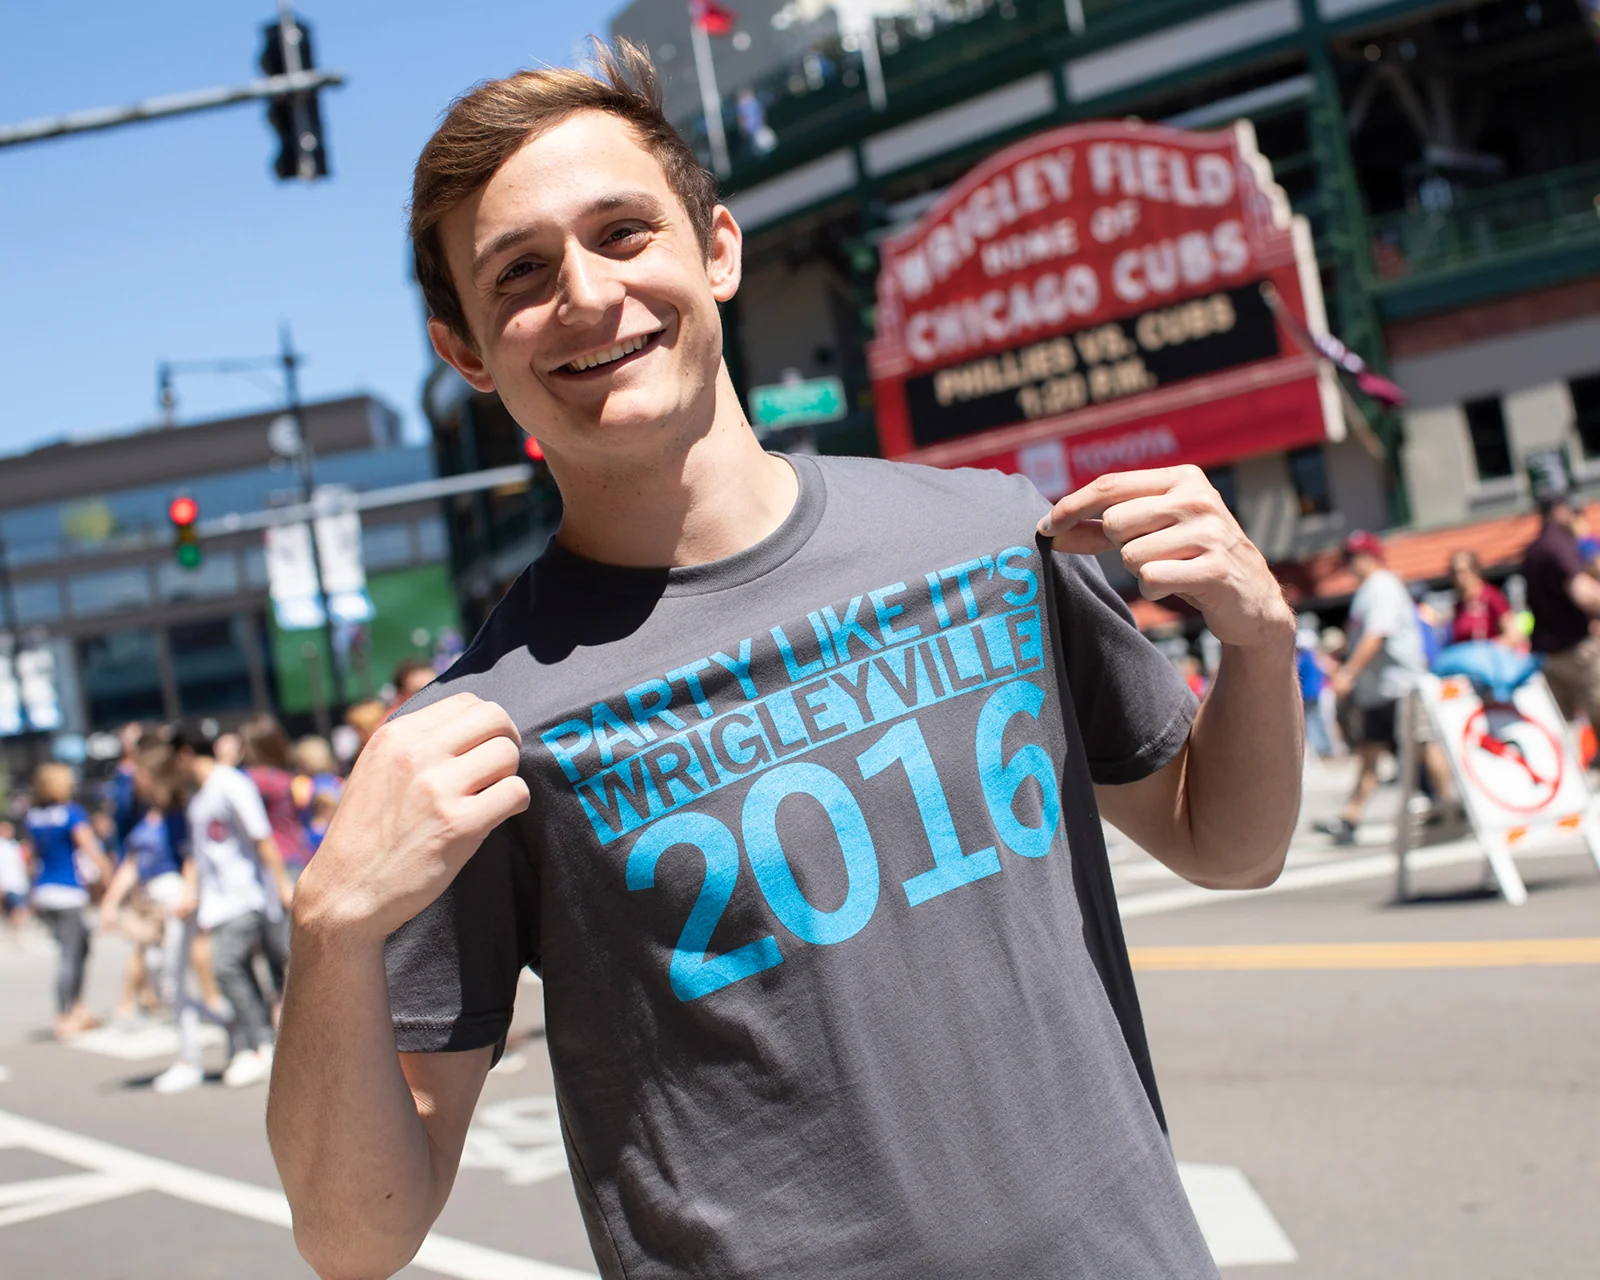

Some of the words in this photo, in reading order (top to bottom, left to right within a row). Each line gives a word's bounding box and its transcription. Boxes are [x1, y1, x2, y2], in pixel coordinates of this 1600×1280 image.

[897, 147, 1075, 299] WRIGLEY
[1088, 142, 1236, 207] FIELD
[907, 264, 1100, 362] CHICAGO
[1112, 219, 1250, 302] CUBS
[980, 217, 1079, 277] HOME
[1090, 199, 1141, 243] OF
[934, 337, 1076, 405] PHILLIES
[1075, 323, 1137, 364] VS.
[1136, 293, 1236, 350] CUBS
[1089, 355, 1158, 402] P.M.
[1072, 425, 1178, 475] TOYOTA
[540, 638, 759, 783] PARTY
[770, 581, 921, 683] LIKE
[925, 546, 1039, 629] IT'S
[576, 606, 1043, 843] WRIGLEYVILLE
[625, 680, 1061, 1002] 2016
